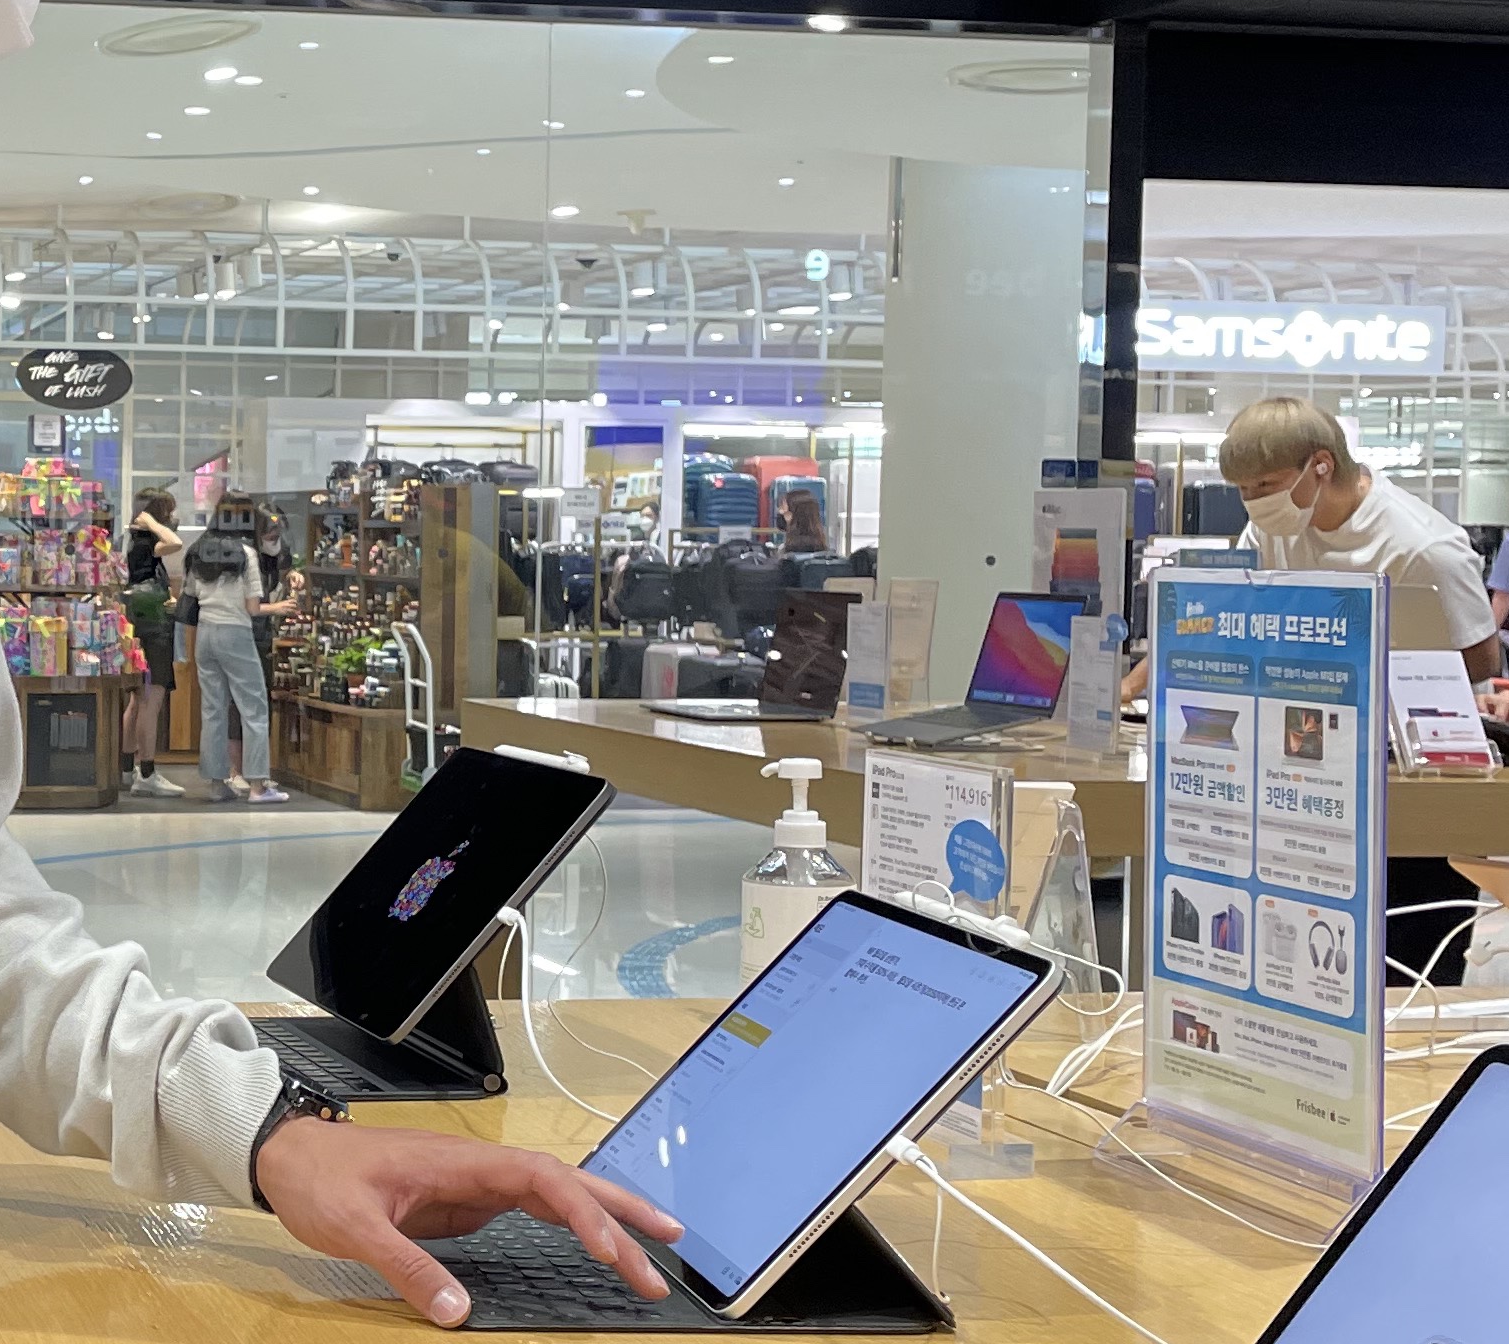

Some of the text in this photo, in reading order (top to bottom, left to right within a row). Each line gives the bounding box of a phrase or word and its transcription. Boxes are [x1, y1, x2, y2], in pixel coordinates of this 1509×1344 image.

[1136, 308, 1432, 367] Samsonite
[29, 362, 114, 385] THE GIFT
[1217, 611, 1246, 640] 최대
[1250, 613, 1280, 642] 혜택
[1284, 615, 1347, 647] 프로모션
[1170, 772, 1204, 797] 12만원
[1265, 786, 1298, 812] 3만원
[1296, 1098, 1326, 1119] Frisbee
